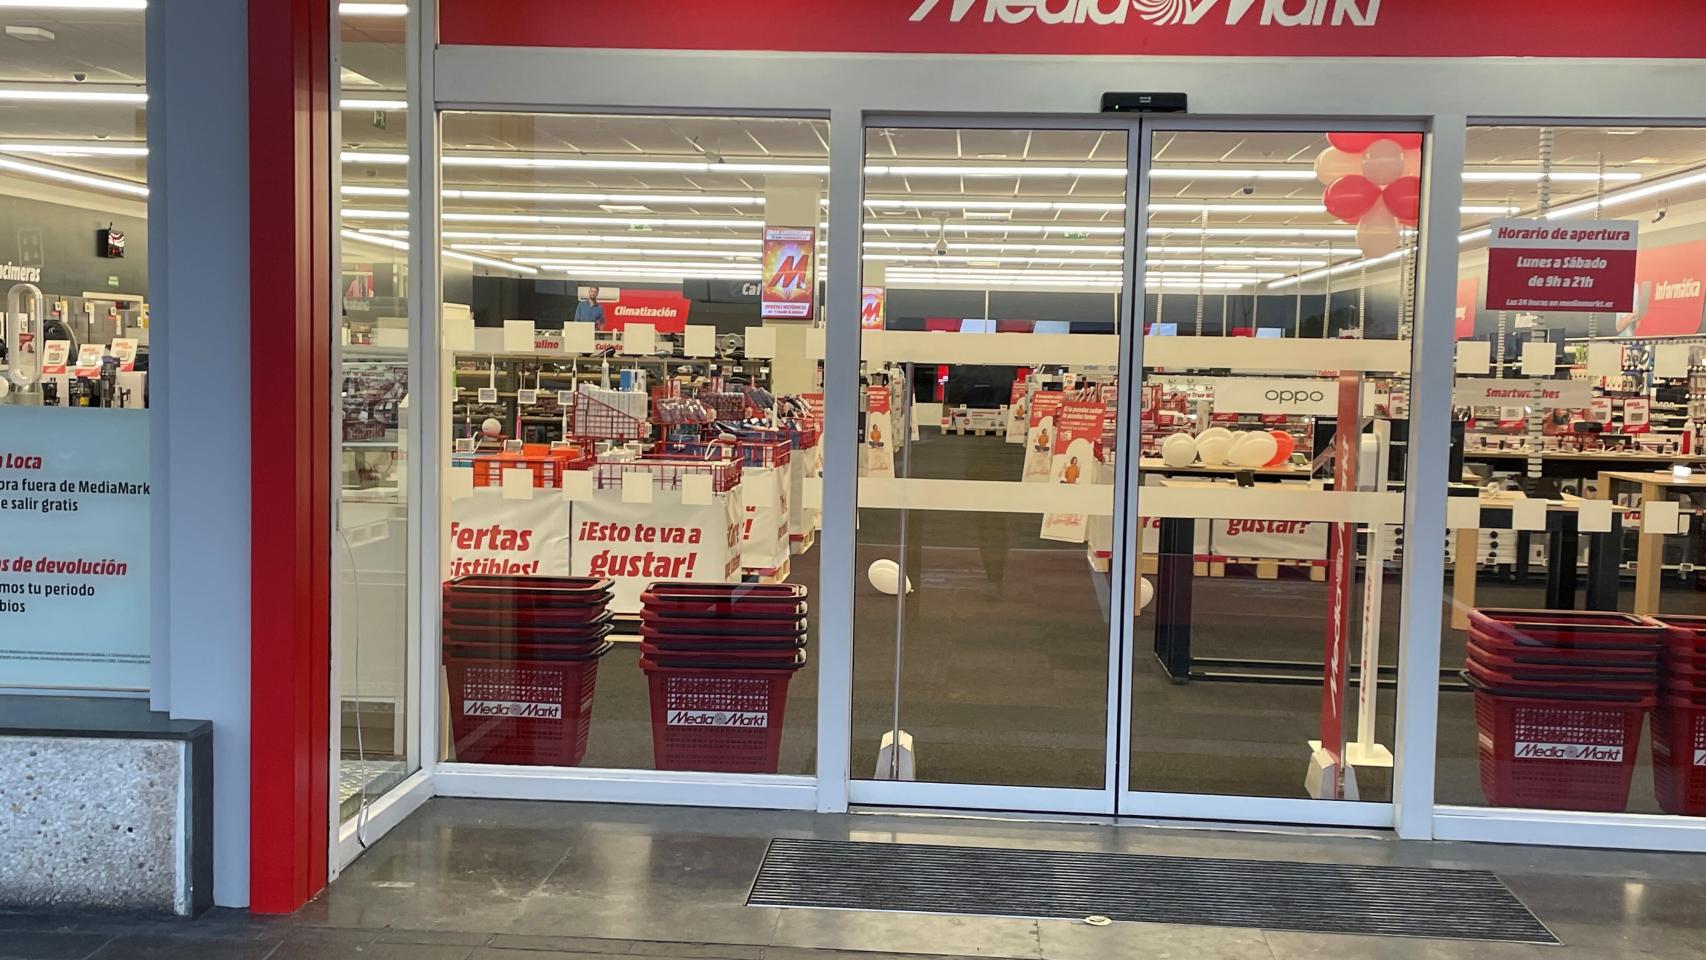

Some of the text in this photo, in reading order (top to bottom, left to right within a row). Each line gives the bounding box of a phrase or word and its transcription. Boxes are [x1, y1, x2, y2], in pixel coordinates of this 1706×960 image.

[1498, 227, 1630, 242] Horario de apertura
[1517, 256, 1607, 269] Lunes a Sábado
[1528, 275, 1594, 288] de 9h a 21h
[1655, 278, 1701, 300] Informática
[615, 306, 677, 318] Climatización
[595, 343, 623, 351] Cuiddo
[1265, 390, 1324, 404] oppo
[1485, 388, 1560, 399] Smartwahes
[6, 453, 42, 469] Loca
[22, 478, 56, 492] fuera
[60, 480, 75, 492] de
[78, 480, 150, 495] MediaMark
[11, 497, 38, 510] salir
[42, 498, 78, 513] gratis
[579, 522, 702, 544] ¡Esto te va a
[0, 557, 127, 576] s de devolución
[588, 550, 697, 579] gustar!
[28, 583, 41, 594] tu
[45, 583, 95, 597] periodo
[466, 702, 559, 717] Media Markt
[669, 712, 765, 726] Media Markt
[1517, 744, 1621, 760] Media Markt
